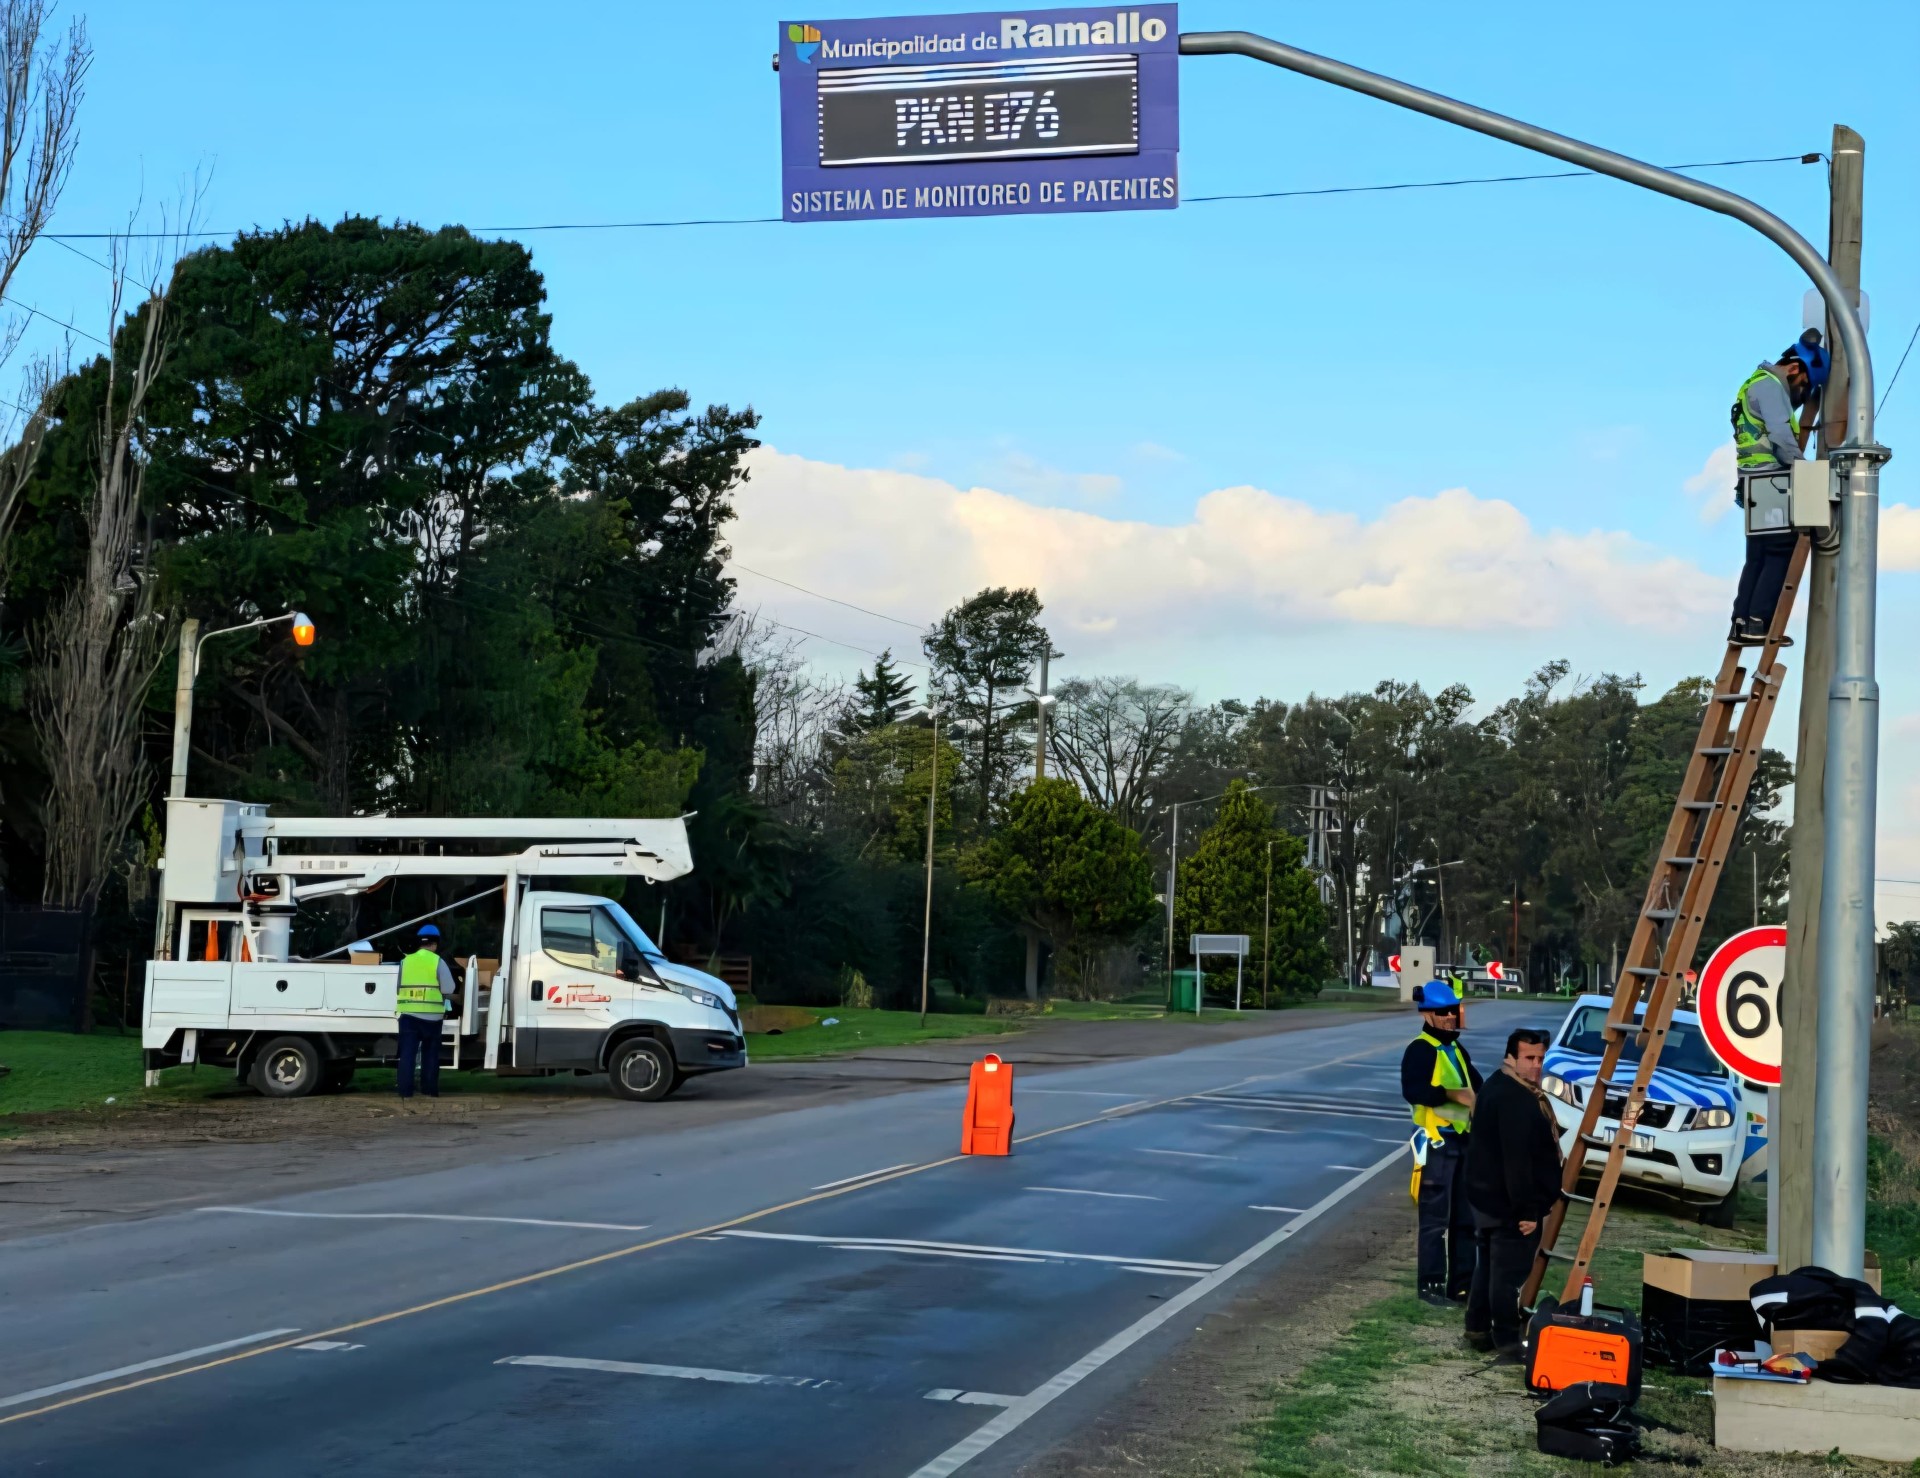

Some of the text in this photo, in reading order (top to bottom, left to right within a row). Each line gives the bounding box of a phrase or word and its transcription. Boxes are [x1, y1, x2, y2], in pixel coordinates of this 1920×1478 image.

[821, 11, 1167, 60] Municipalidad de Ramallo
[895, 95, 974, 146] PKN
[791, 177, 1175, 214] SISTEMA DE MONITOREO DE PATENTES
[1726, 970, 1783, 1039] 6
